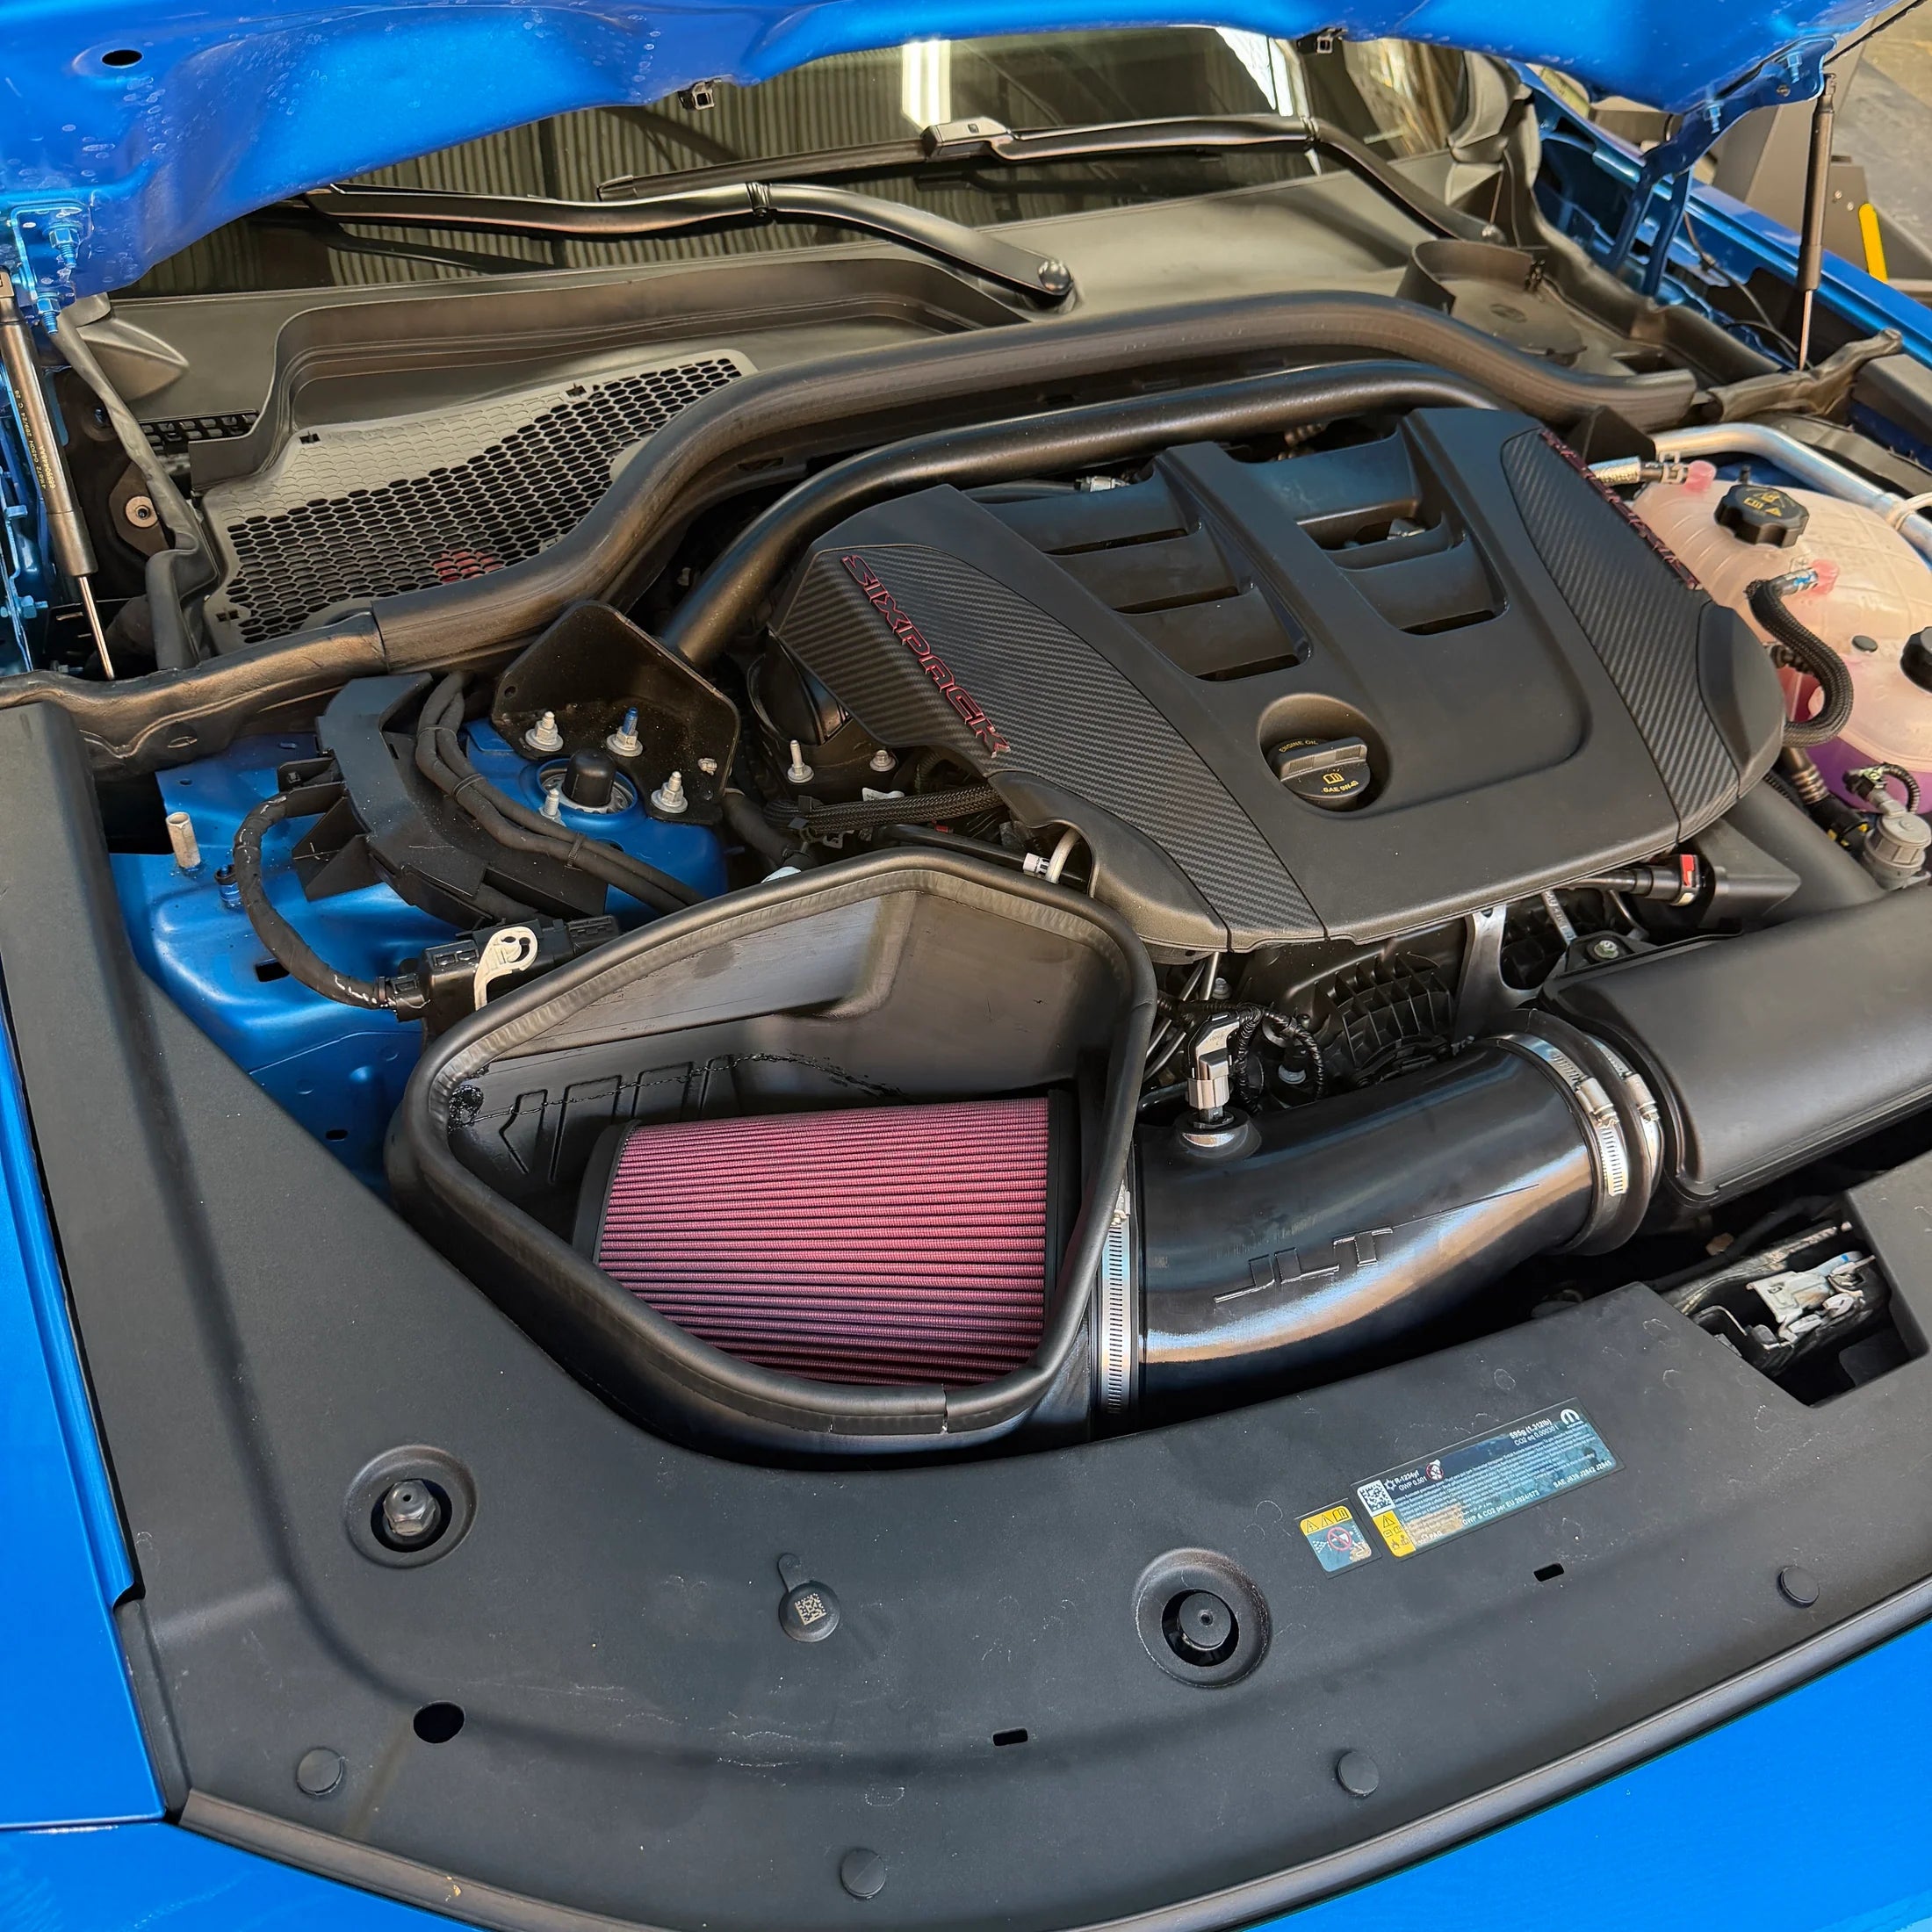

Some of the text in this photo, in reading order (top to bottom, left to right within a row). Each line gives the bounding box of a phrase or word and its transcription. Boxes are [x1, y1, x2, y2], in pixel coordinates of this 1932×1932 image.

[840, 554, 1011, 758] SIXPACK
[1279, 740, 1304, 753] ENGINE
[1213, 1226, 1393, 1303] JLT
[1395, 1470, 1420, 1484] R-1234yf
[1483, 1508, 1496, 1517] CO2
[1496, 1504, 1505, 1513] per
